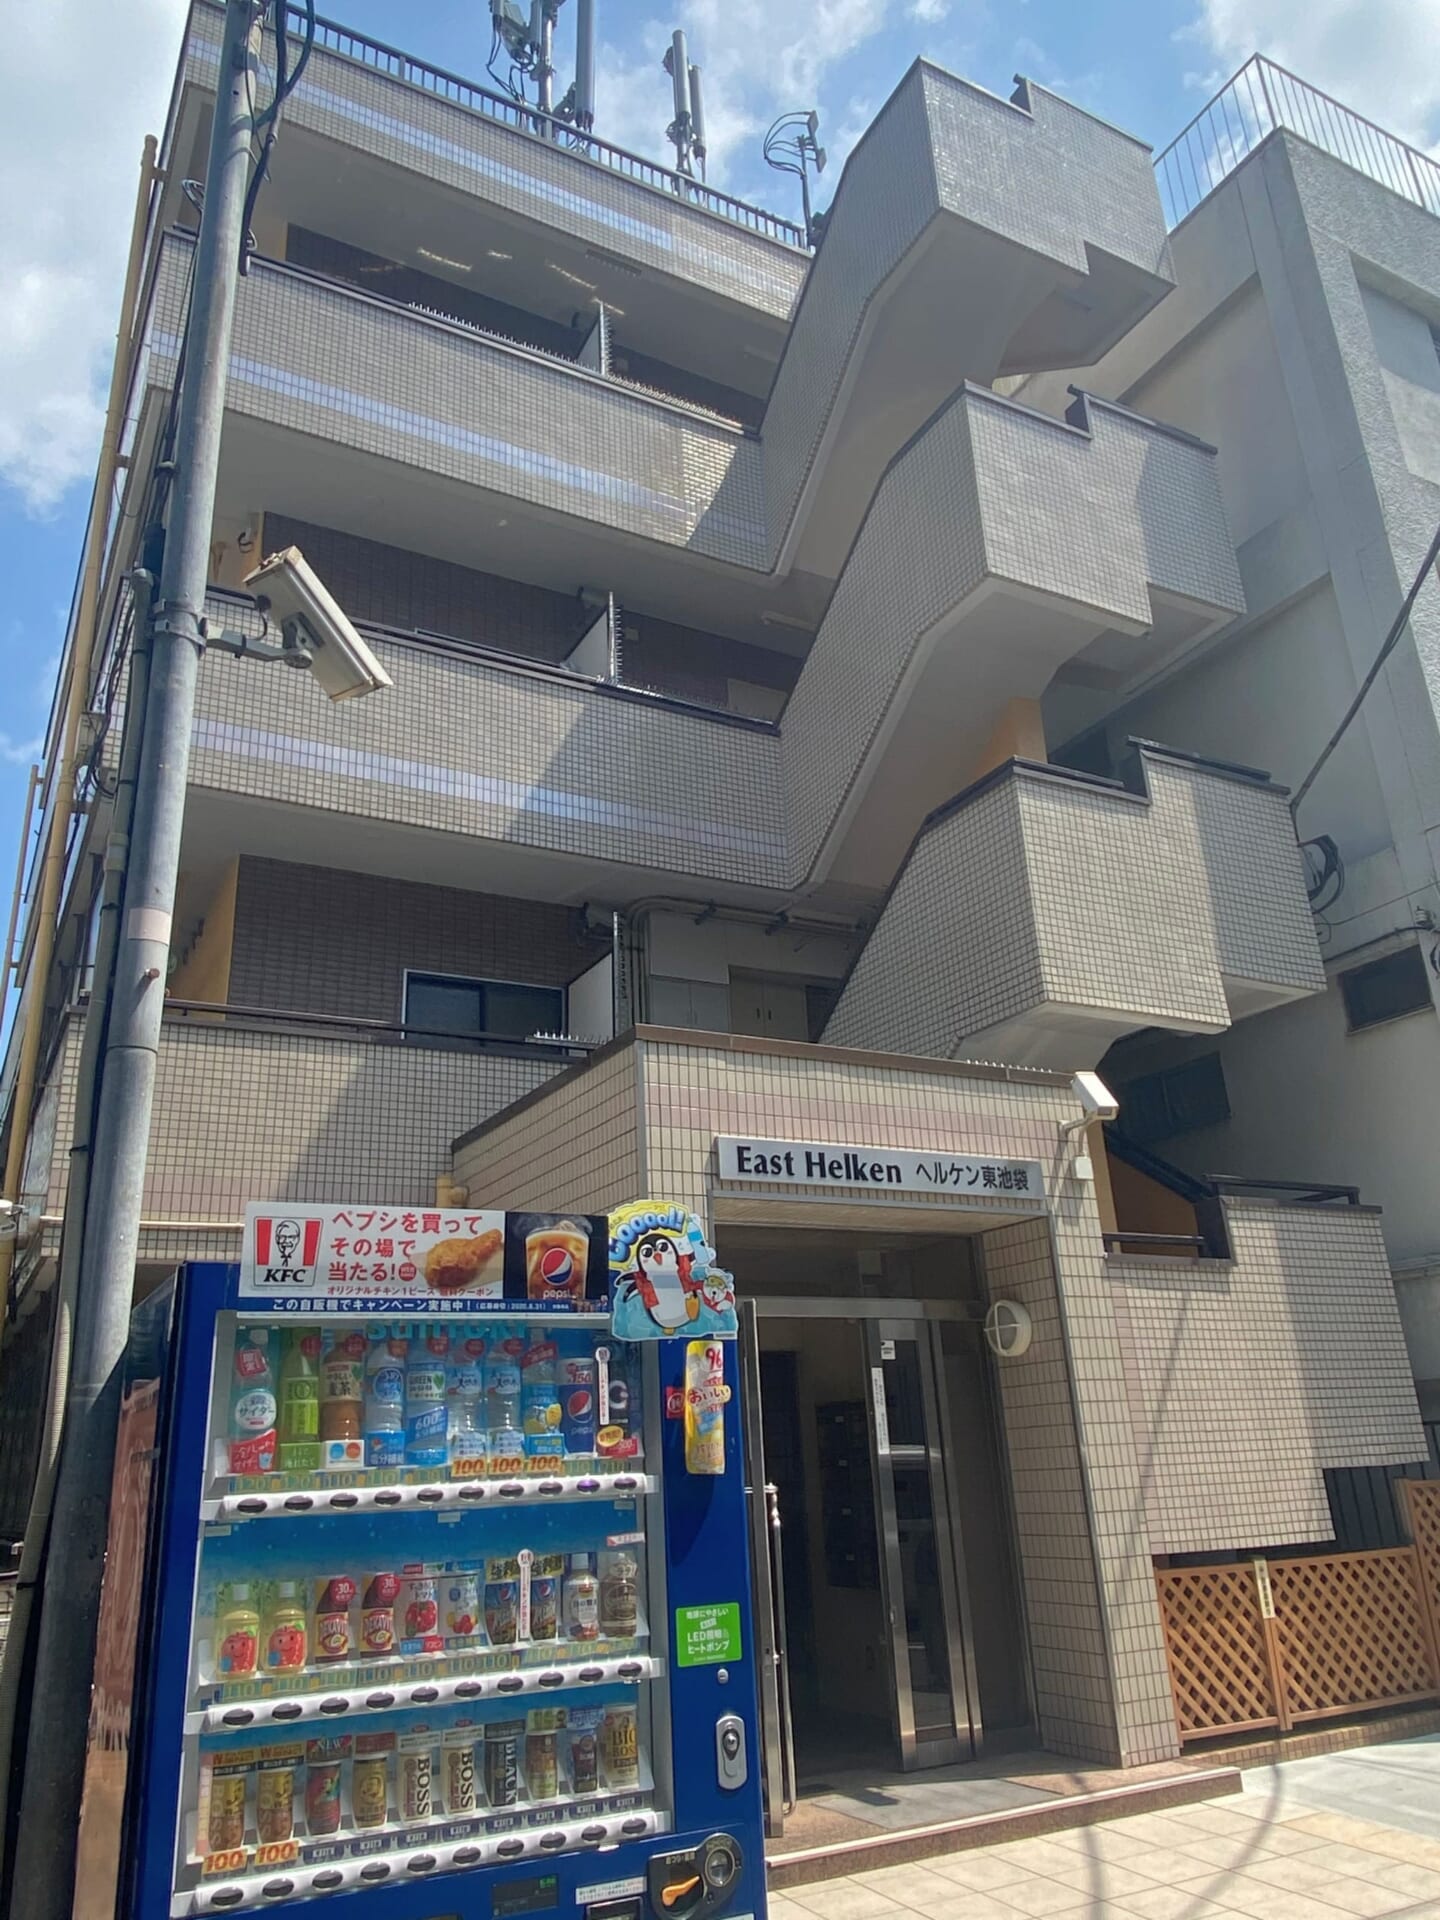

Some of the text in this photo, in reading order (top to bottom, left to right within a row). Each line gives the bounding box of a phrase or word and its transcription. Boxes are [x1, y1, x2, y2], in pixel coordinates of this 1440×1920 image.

[736, 1145, 903, 1184] East Helken
[915, 1160, 1030, 1191] ヘルケン東池袋
[332, 1210, 483, 1235] ペプシを買って
[330, 1237, 416, 1259] その場で
[263, 1268, 306, 1283] KFC
[453, 1458, 484, 1475] 100
[490, 1457, 521, 1473] 100
[529, 1455, 560, 1471] 100
[687, 1639, 730, 1655] ヒートポンプ
[460, 1751, 474, 1809] BOSS
[504, 1742, 518, 1803] BLACK
[416, 1757, 431, 1816] BOSS
[205, 1851, 243, 1872] 100
[256, 1842, 297, 1863] 100
